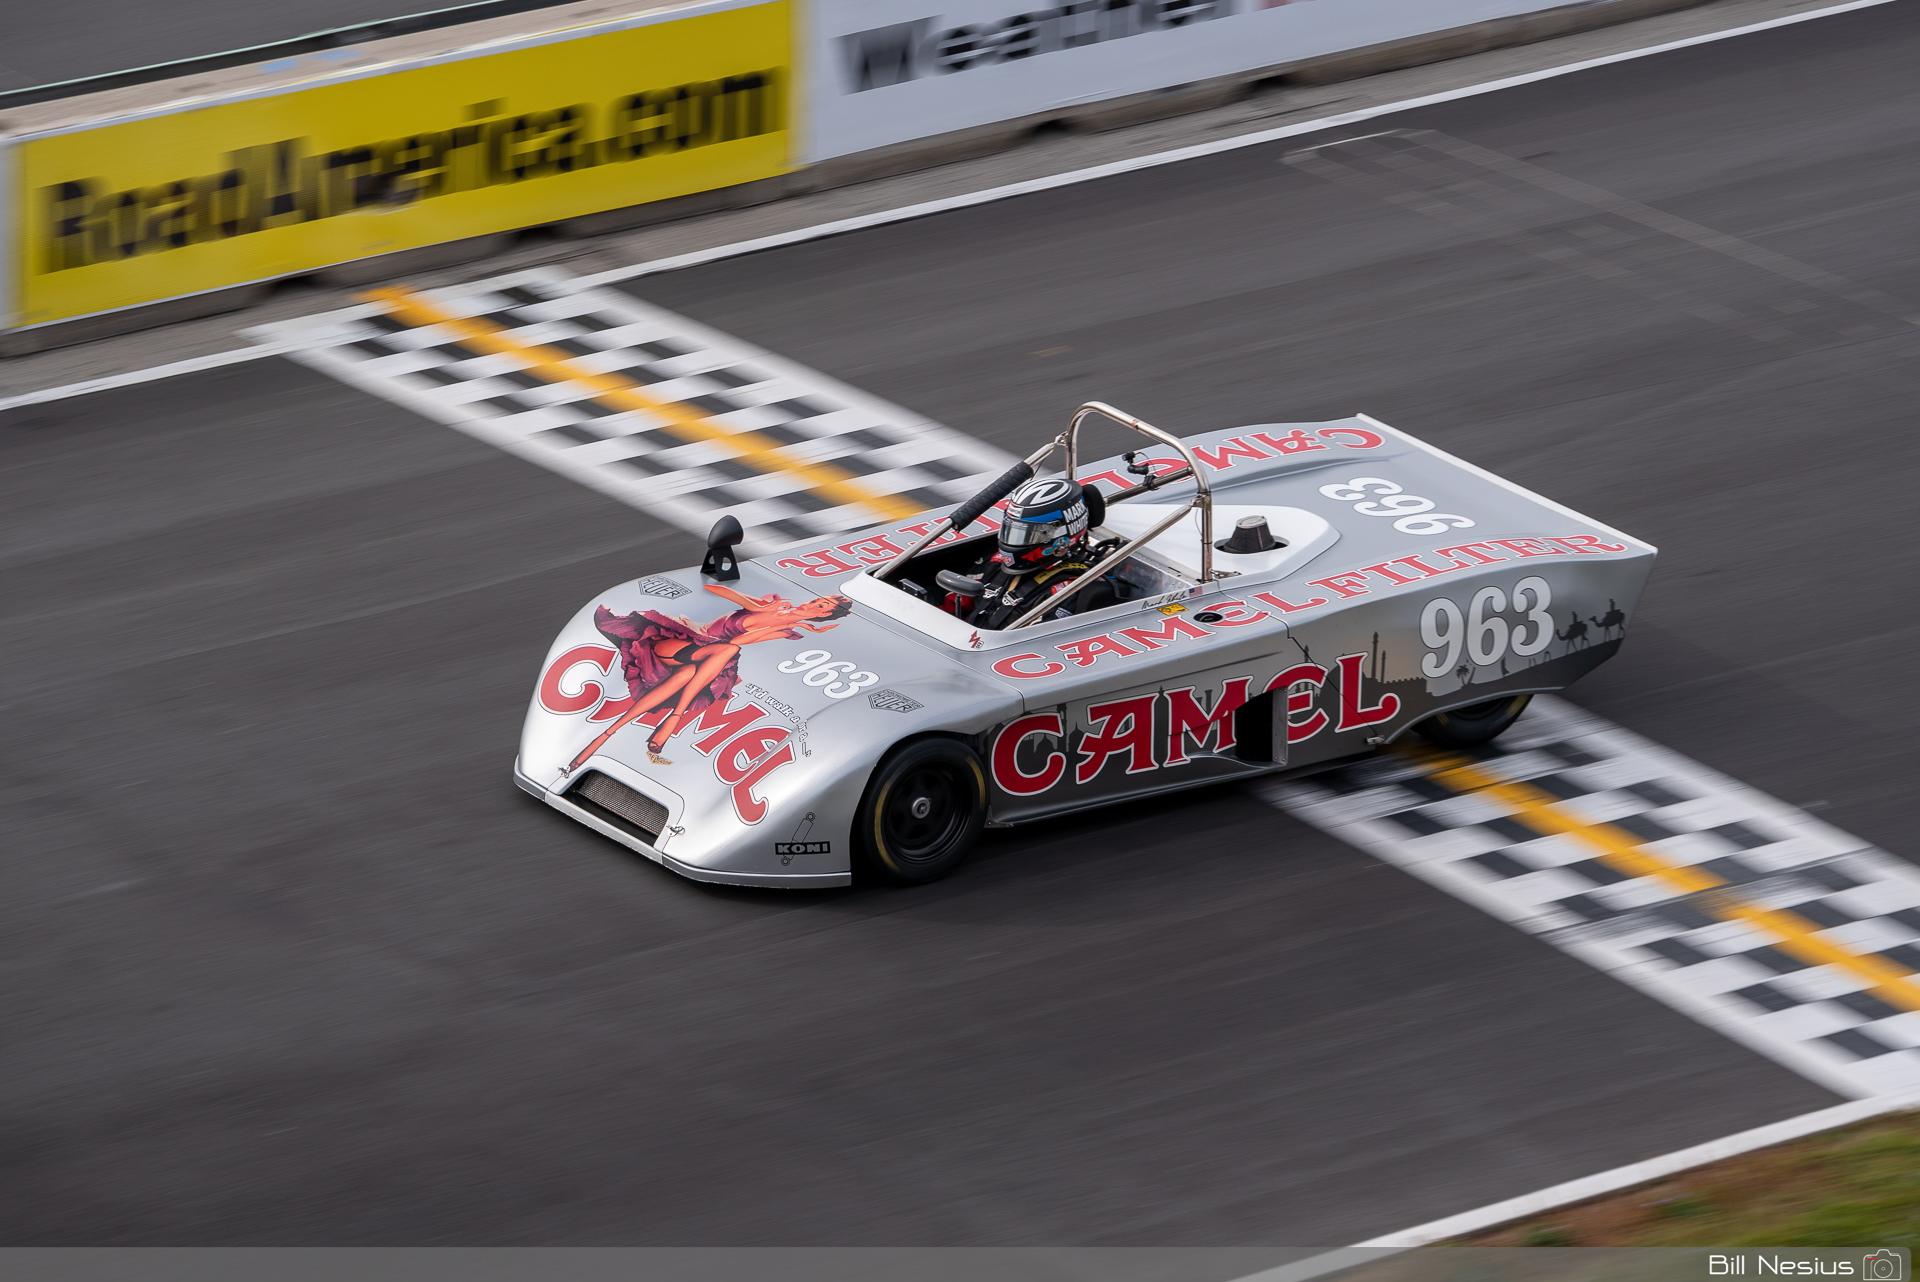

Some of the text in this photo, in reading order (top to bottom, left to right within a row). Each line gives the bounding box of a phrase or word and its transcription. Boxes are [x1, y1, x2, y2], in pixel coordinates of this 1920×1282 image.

[834, 0, 1242, 95] Weathe
[38, 66, 784, 275] RoadAmerica.com
[1062, 499, 1087, 523] MARK
[1317, 477, 1477, 536] 963
[1419, 575, 1556, 679] 963
[776, 649, 880, 699] 963
[764, 696, 795, 718] walk
[789, 715, 801, 724] a
[991, 651, 1401, 797] CAMEL
[777, 843, 828, 854] KONI
